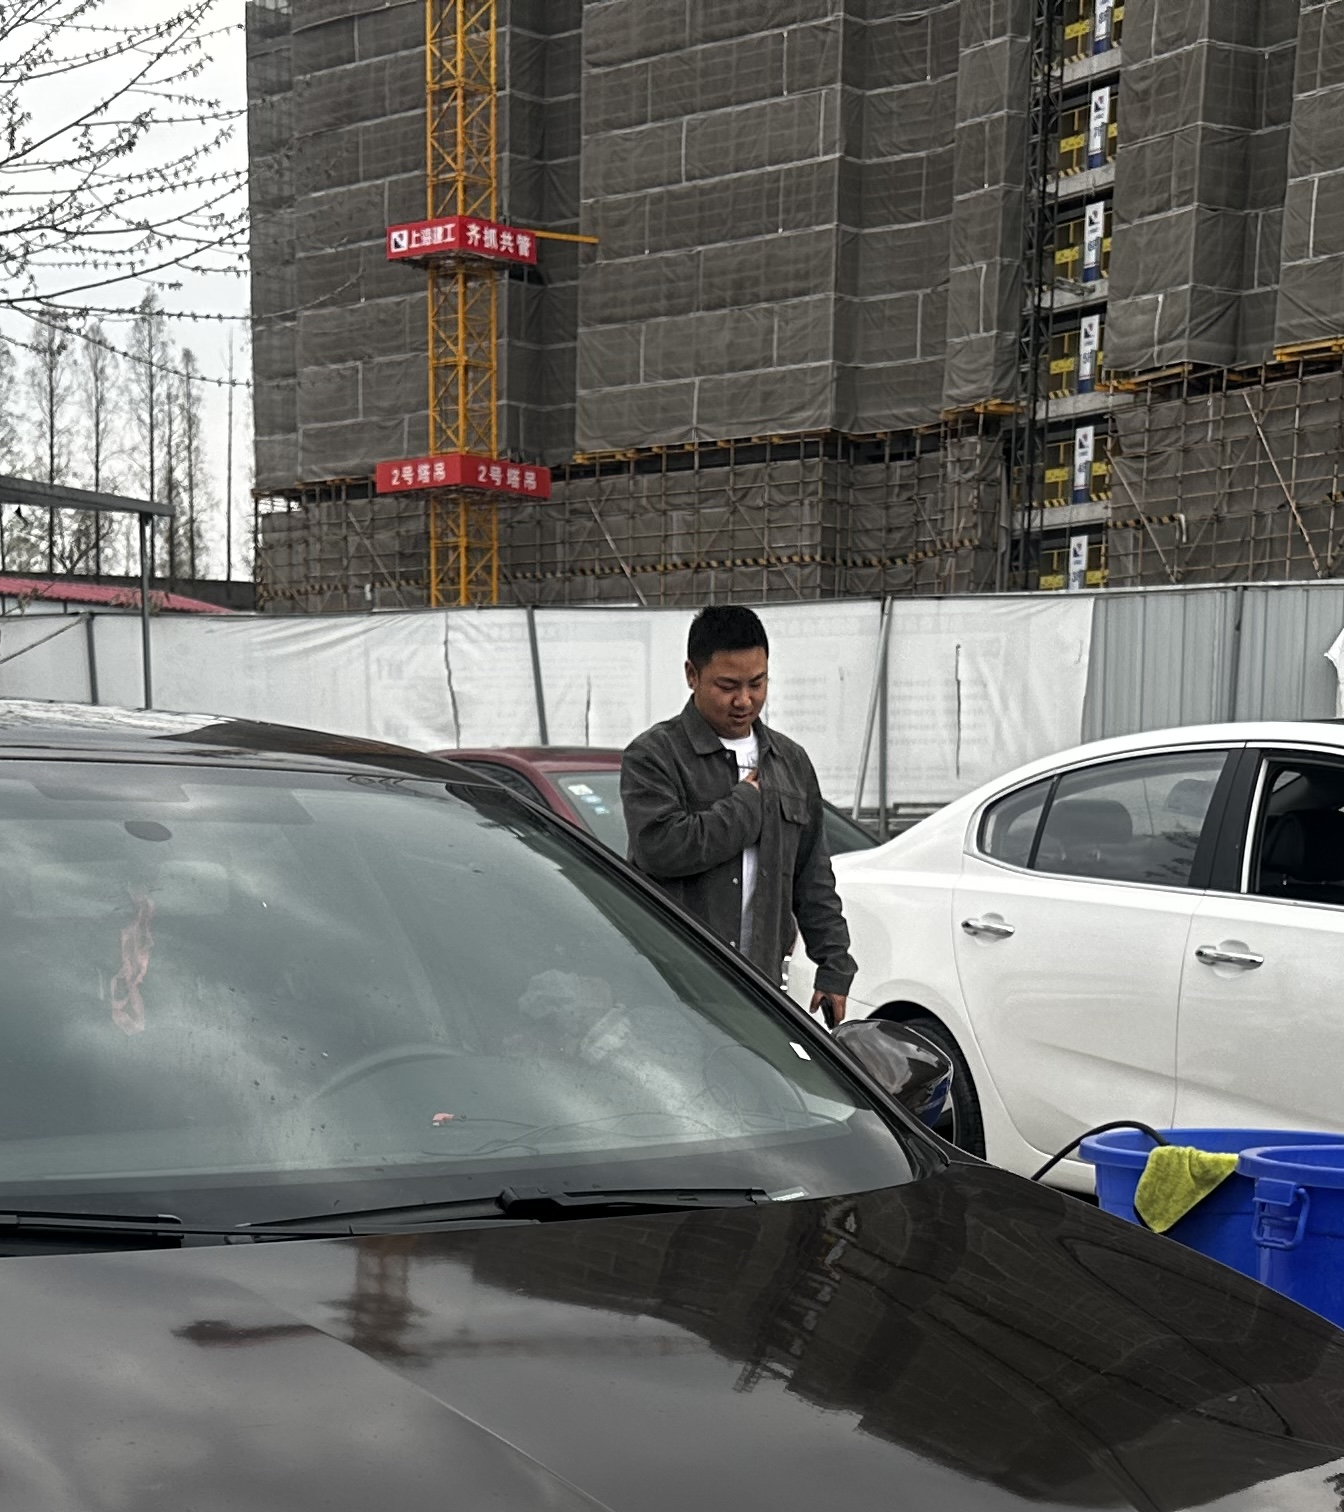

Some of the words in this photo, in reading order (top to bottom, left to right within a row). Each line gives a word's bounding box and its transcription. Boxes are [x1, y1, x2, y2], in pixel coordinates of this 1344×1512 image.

[466, 222, 532, 258] 齐抓共管
[391, 461, 446, 486] 2号塔吊
[477, 465, 537, 491] 2号塔吊
